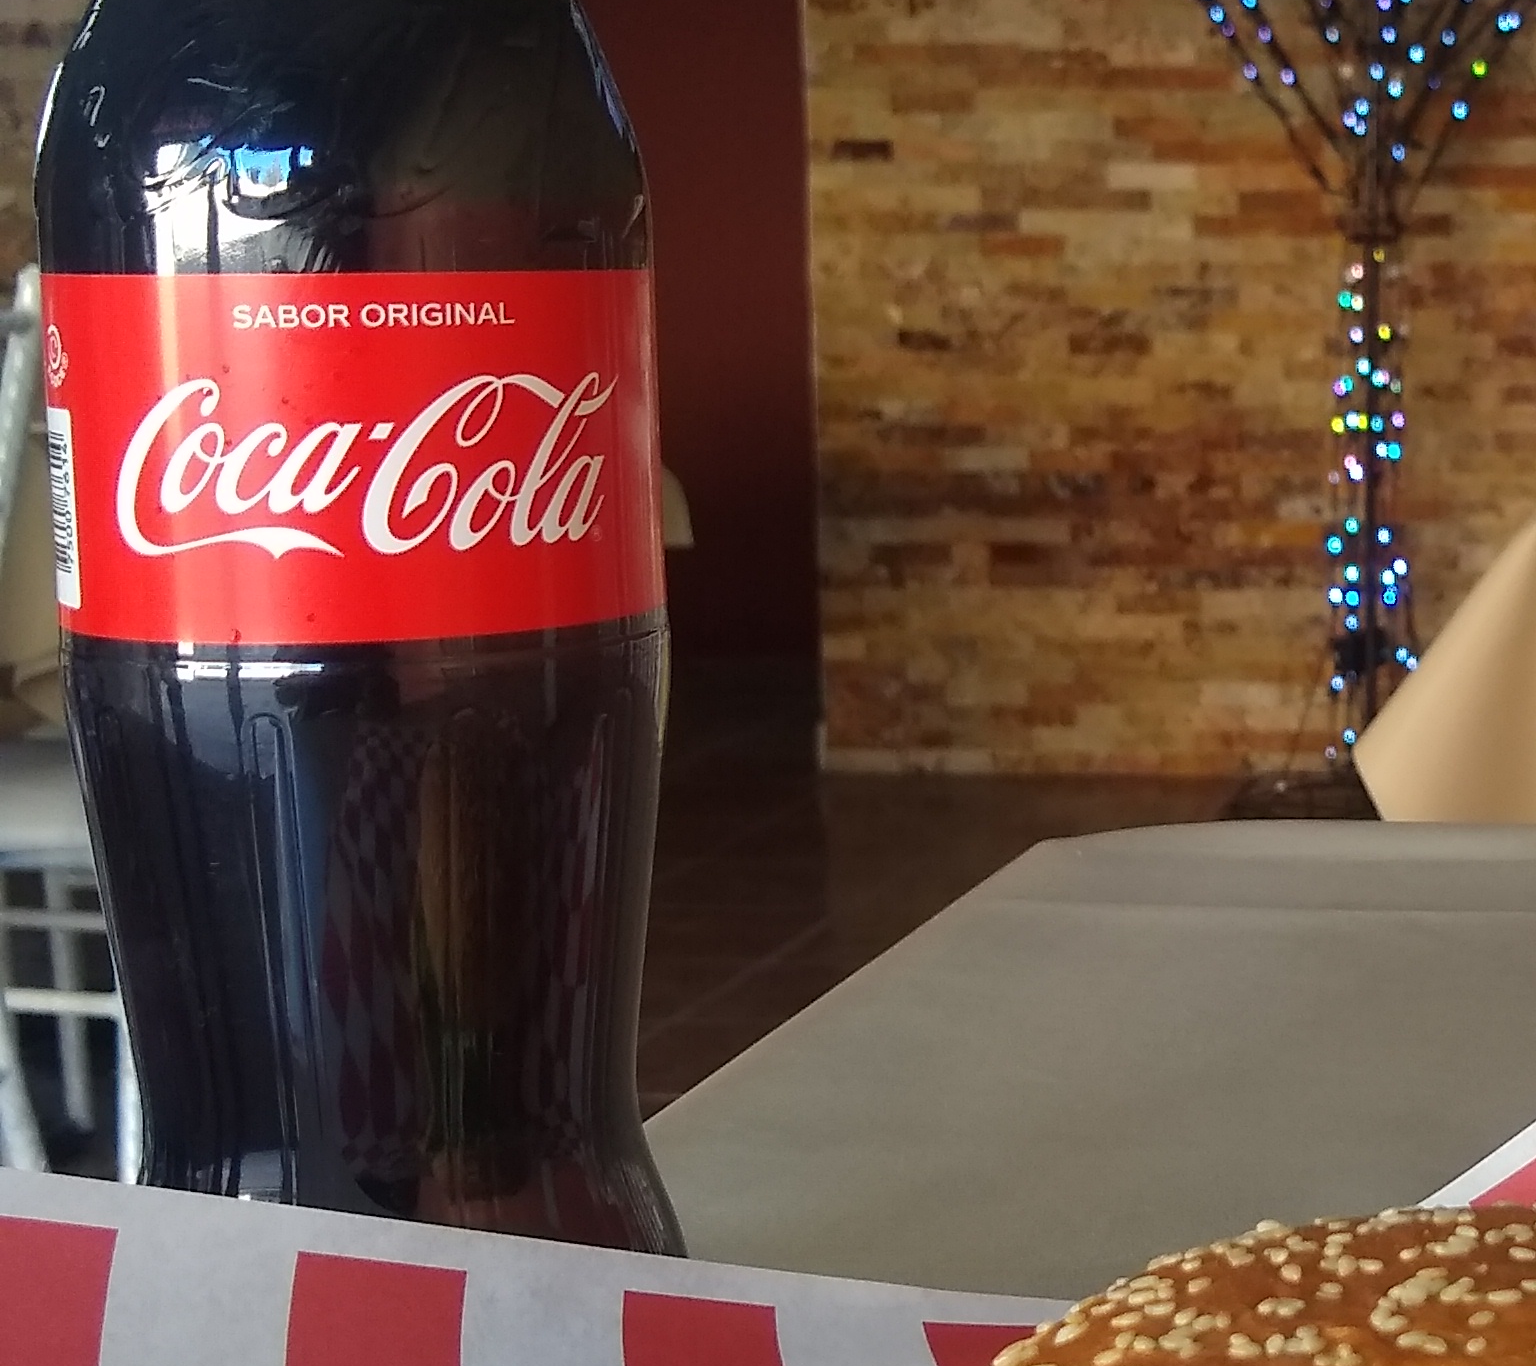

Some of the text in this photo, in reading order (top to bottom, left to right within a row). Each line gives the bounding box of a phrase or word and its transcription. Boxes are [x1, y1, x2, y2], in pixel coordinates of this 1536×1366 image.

[231, 302, 516, 329] SABOR ORIGINAL
[116, 371, 619, 559] Coca-Cola
